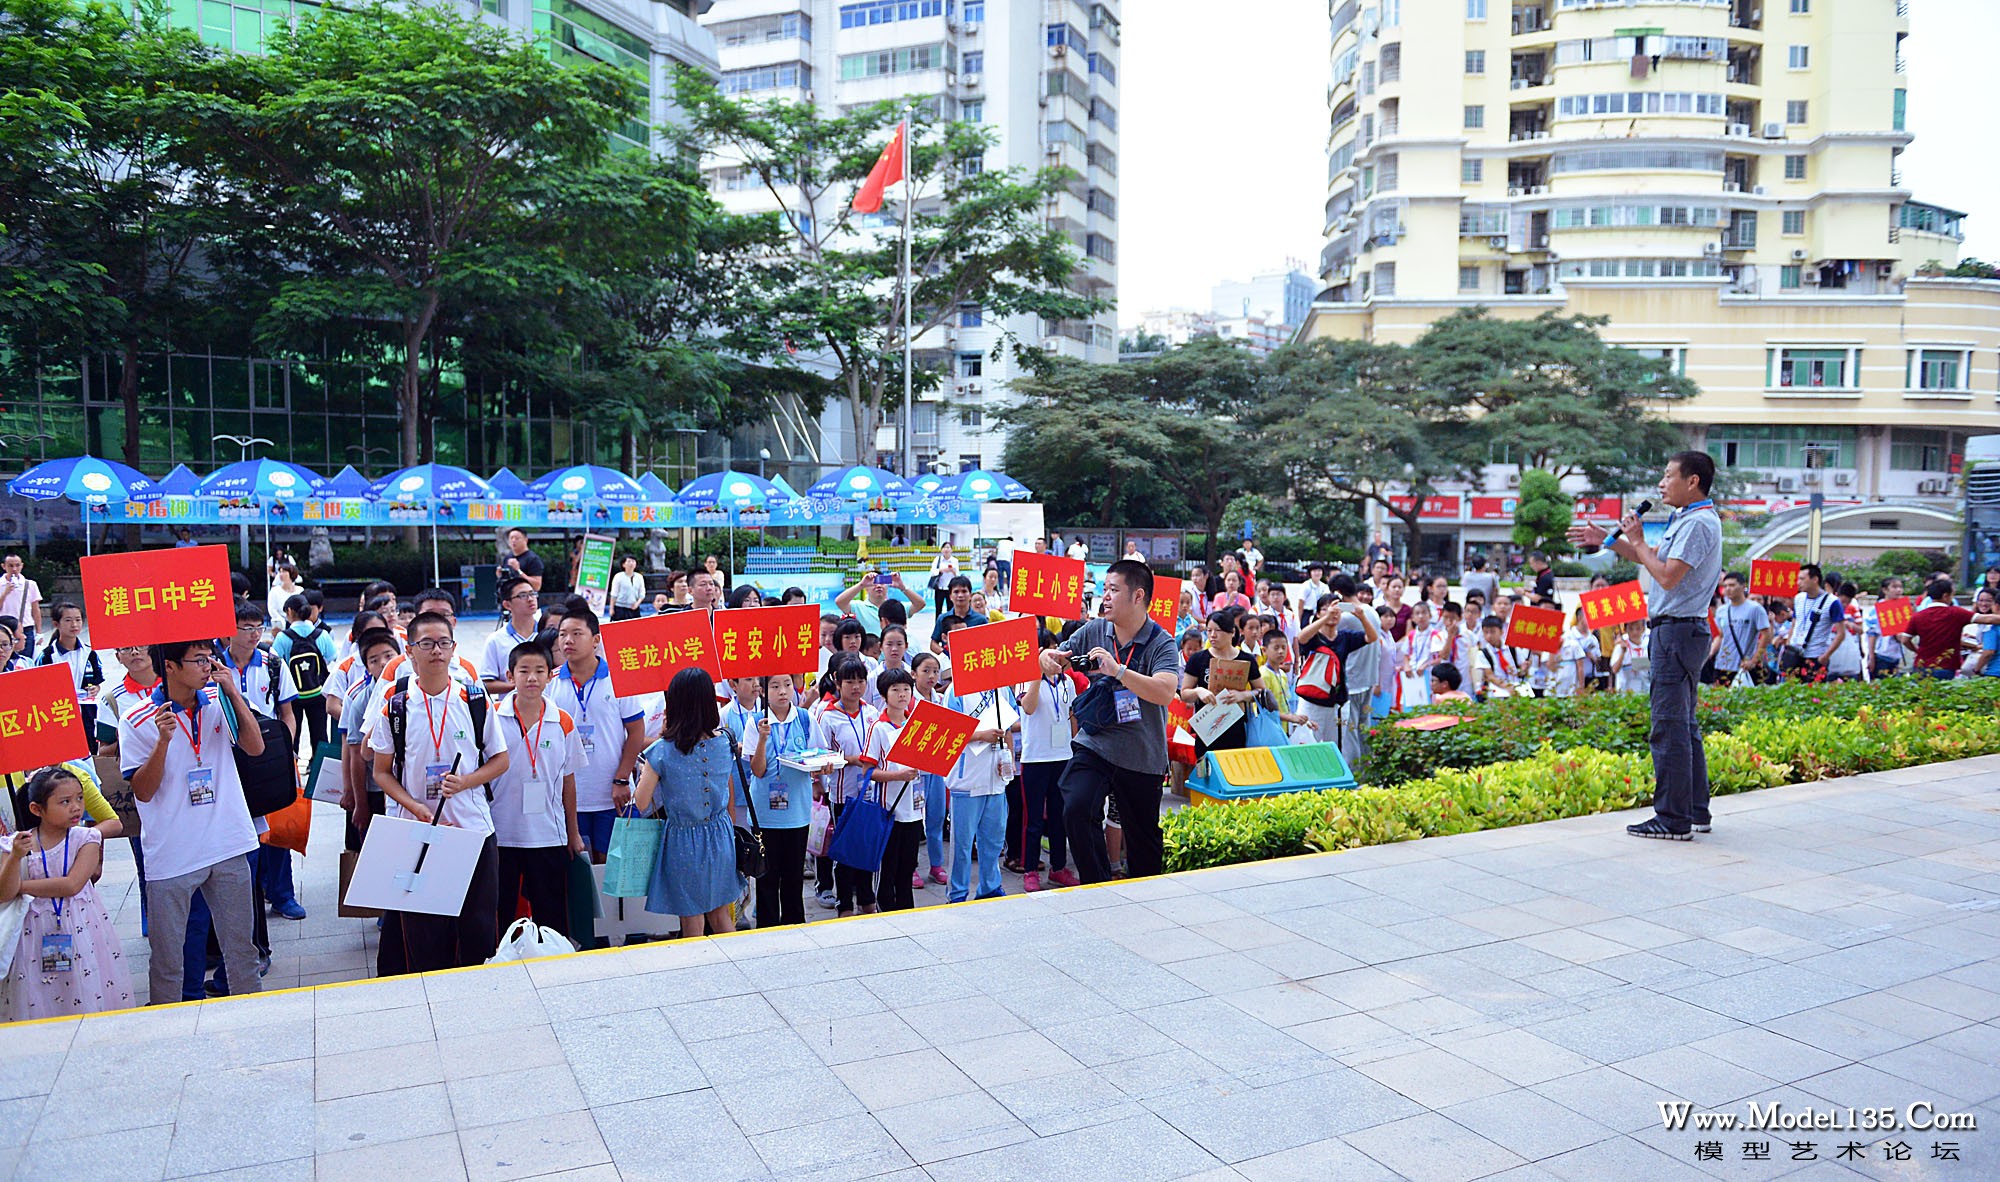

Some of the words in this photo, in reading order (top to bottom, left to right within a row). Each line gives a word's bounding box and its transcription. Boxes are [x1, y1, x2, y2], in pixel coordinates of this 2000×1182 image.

[303, 501, 382, 520] 盖世英
[104, 578, 217, 617] 灌口中学
[1016, 566, 1079, 605] 寨上小学
[1586, 591, 1642, 620] 侨英小学
[722, 623, 813, 661] 定安小学
[1514, 619, 1558, 639] 槟榔小学
[618, 636, 705, 671] 莲龙小学
[963, 639, 1031, 673] 乐海小学
[0, 698, 76, 738] 区小学
[901, 719, 966, 760] 双塔小学
